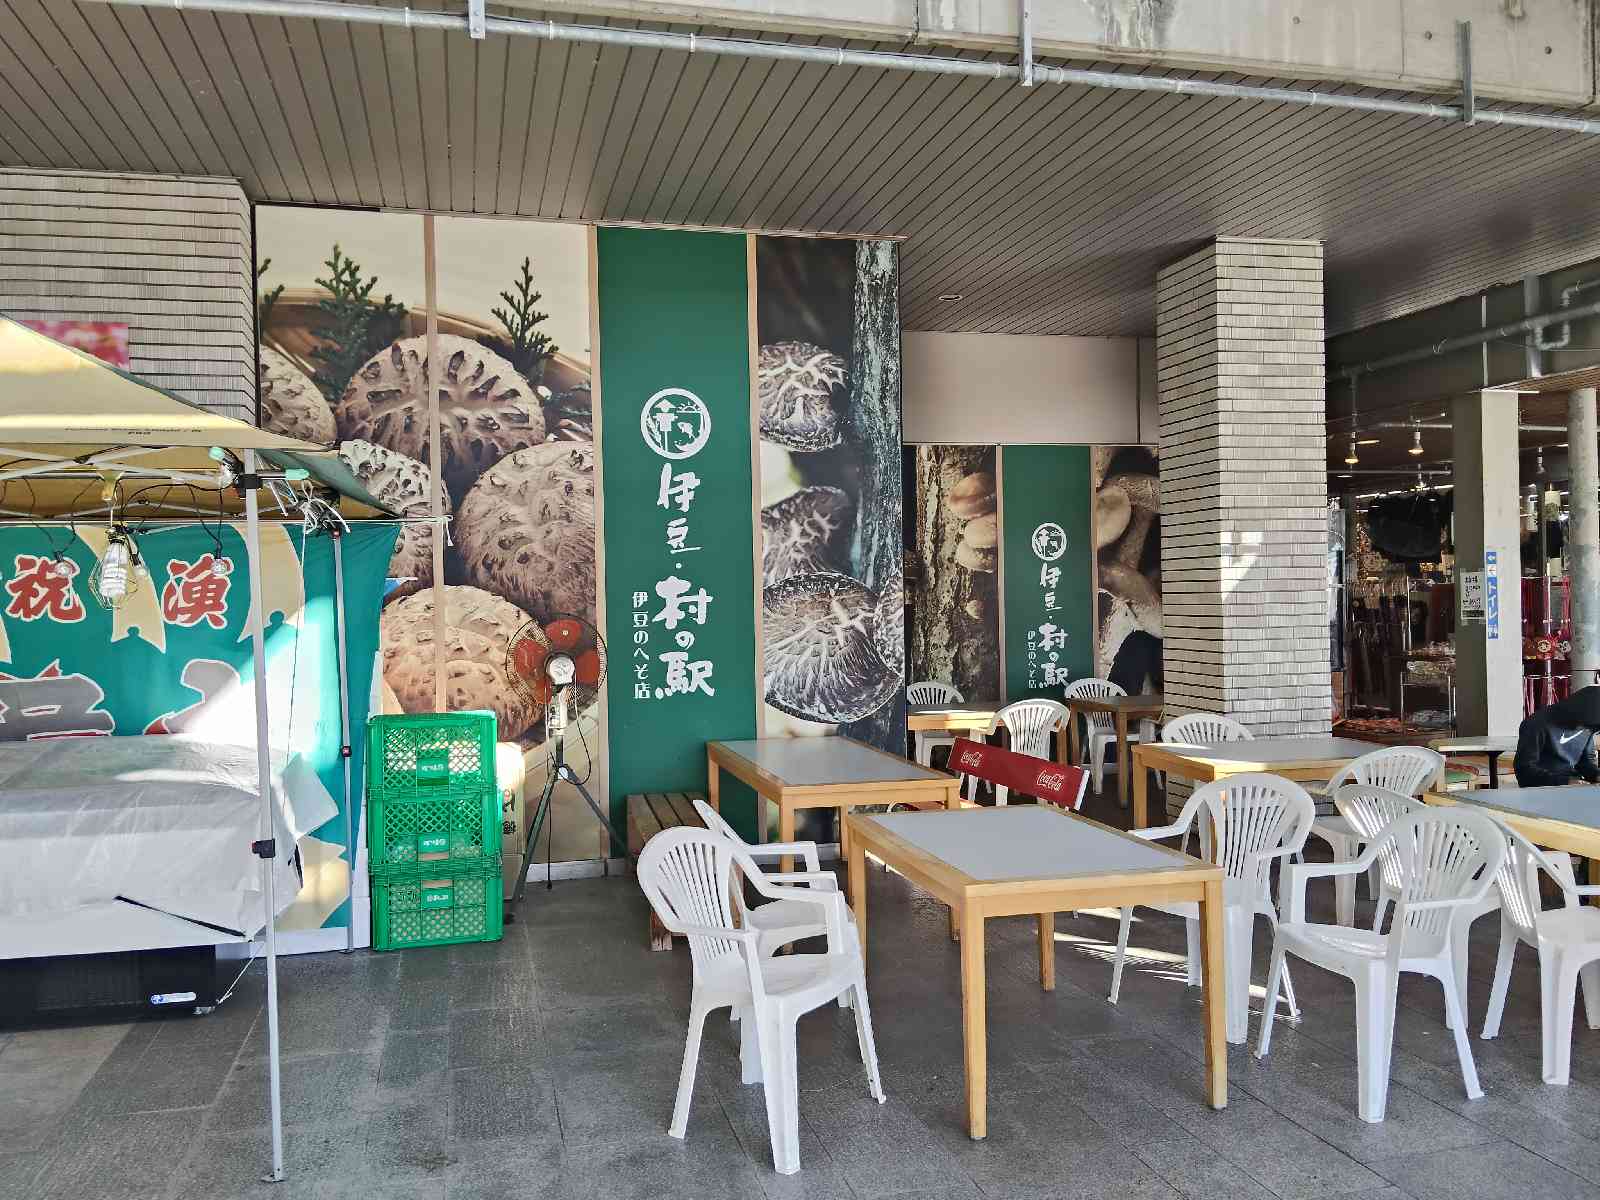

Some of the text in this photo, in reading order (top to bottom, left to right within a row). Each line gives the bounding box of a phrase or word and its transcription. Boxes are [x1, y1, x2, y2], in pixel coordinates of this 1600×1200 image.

[5, 554, 87, 624] 祝
[632, 590, 650, 700] 伊豆のへそ店
